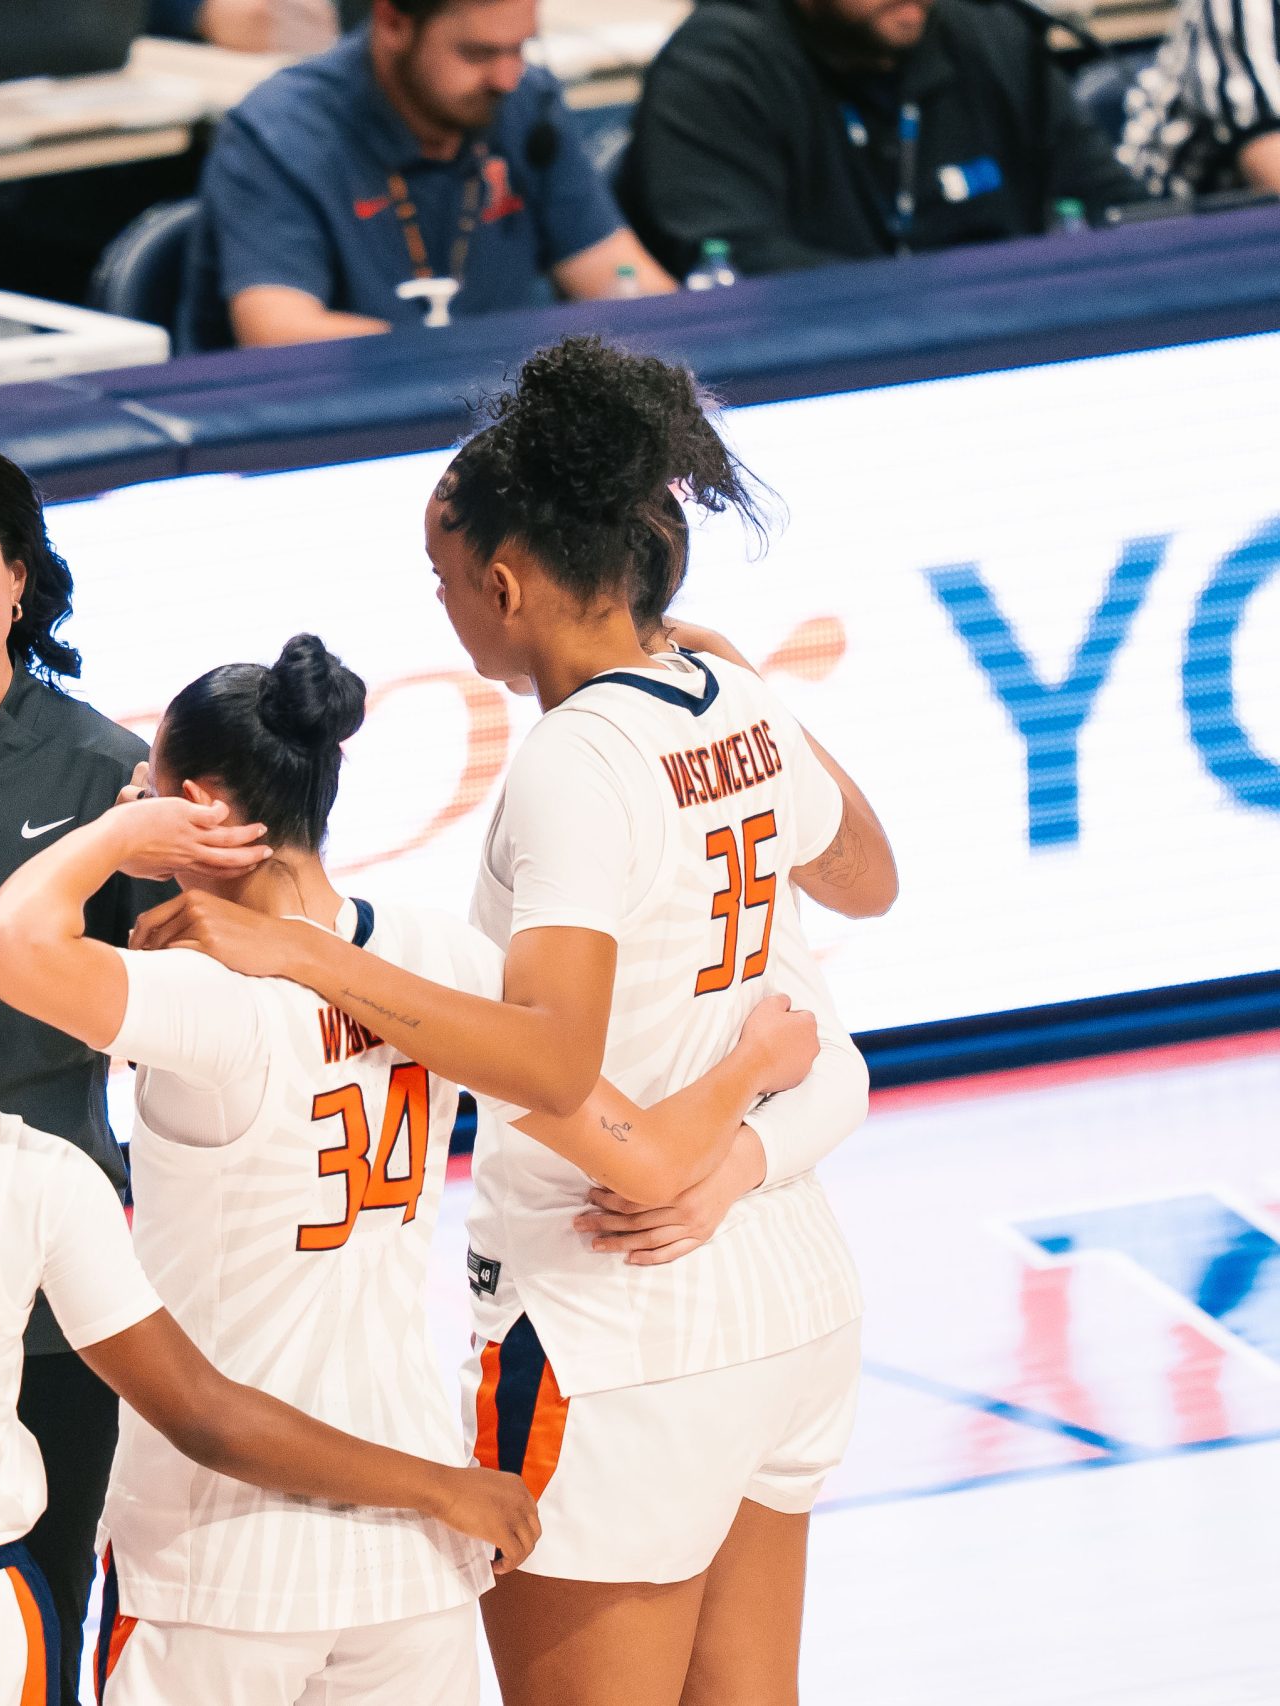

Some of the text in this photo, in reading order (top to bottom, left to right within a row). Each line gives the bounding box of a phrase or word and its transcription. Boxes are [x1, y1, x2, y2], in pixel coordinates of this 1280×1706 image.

[694, 809, 778, 998] 35
[295, 1060, 430, 1252] 34
[480, 1268, 491, 1282] 48
